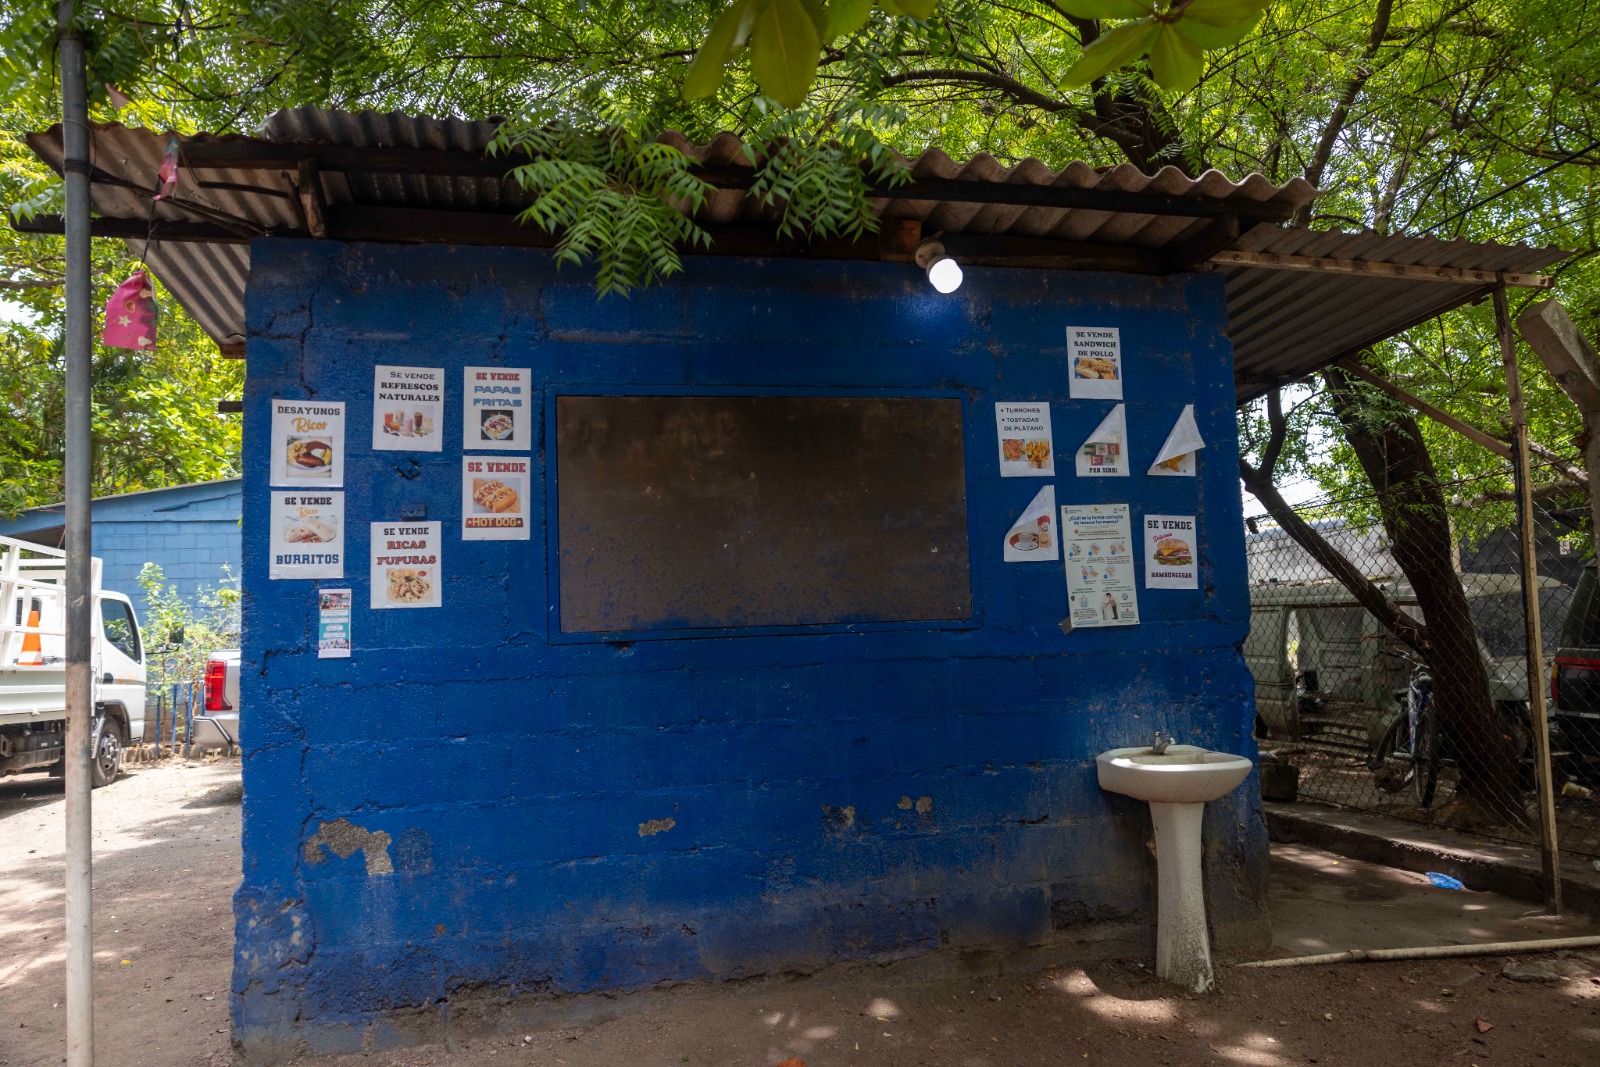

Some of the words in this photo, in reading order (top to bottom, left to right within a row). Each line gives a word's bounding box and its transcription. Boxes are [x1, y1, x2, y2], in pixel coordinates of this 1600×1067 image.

[476, 372, 487, 380] SE
[490, 373, 519, 381] VENDE
[381, 382, 438, 390] REFRESCOS
[474, 386, 521, 394] PAPAS
[379, 393, 440, 401] NATURALES
[473, 398, 522, 407] FRITAS
[277, 406, 340, 415] DESAYUNOS
[291, 417, 327, 433] Ricos
[468, 462, 482, 472] SE
[487, 462, 526, 472] VENDE
[284, 497, 296, 505] SE
[300, 497, 332, 505] VENDE
[473, 518, 492, 526] HOT
[496, 518, 516, 526] DOG
[1148, 520, 1159, 528] SE
[1162, 521, 1192, 529] VENDE
[398, 527, 429, 535] VENDE
[387, 540, 426, 550] RICAS
[276, 554, 339, 564] BURRITOS
